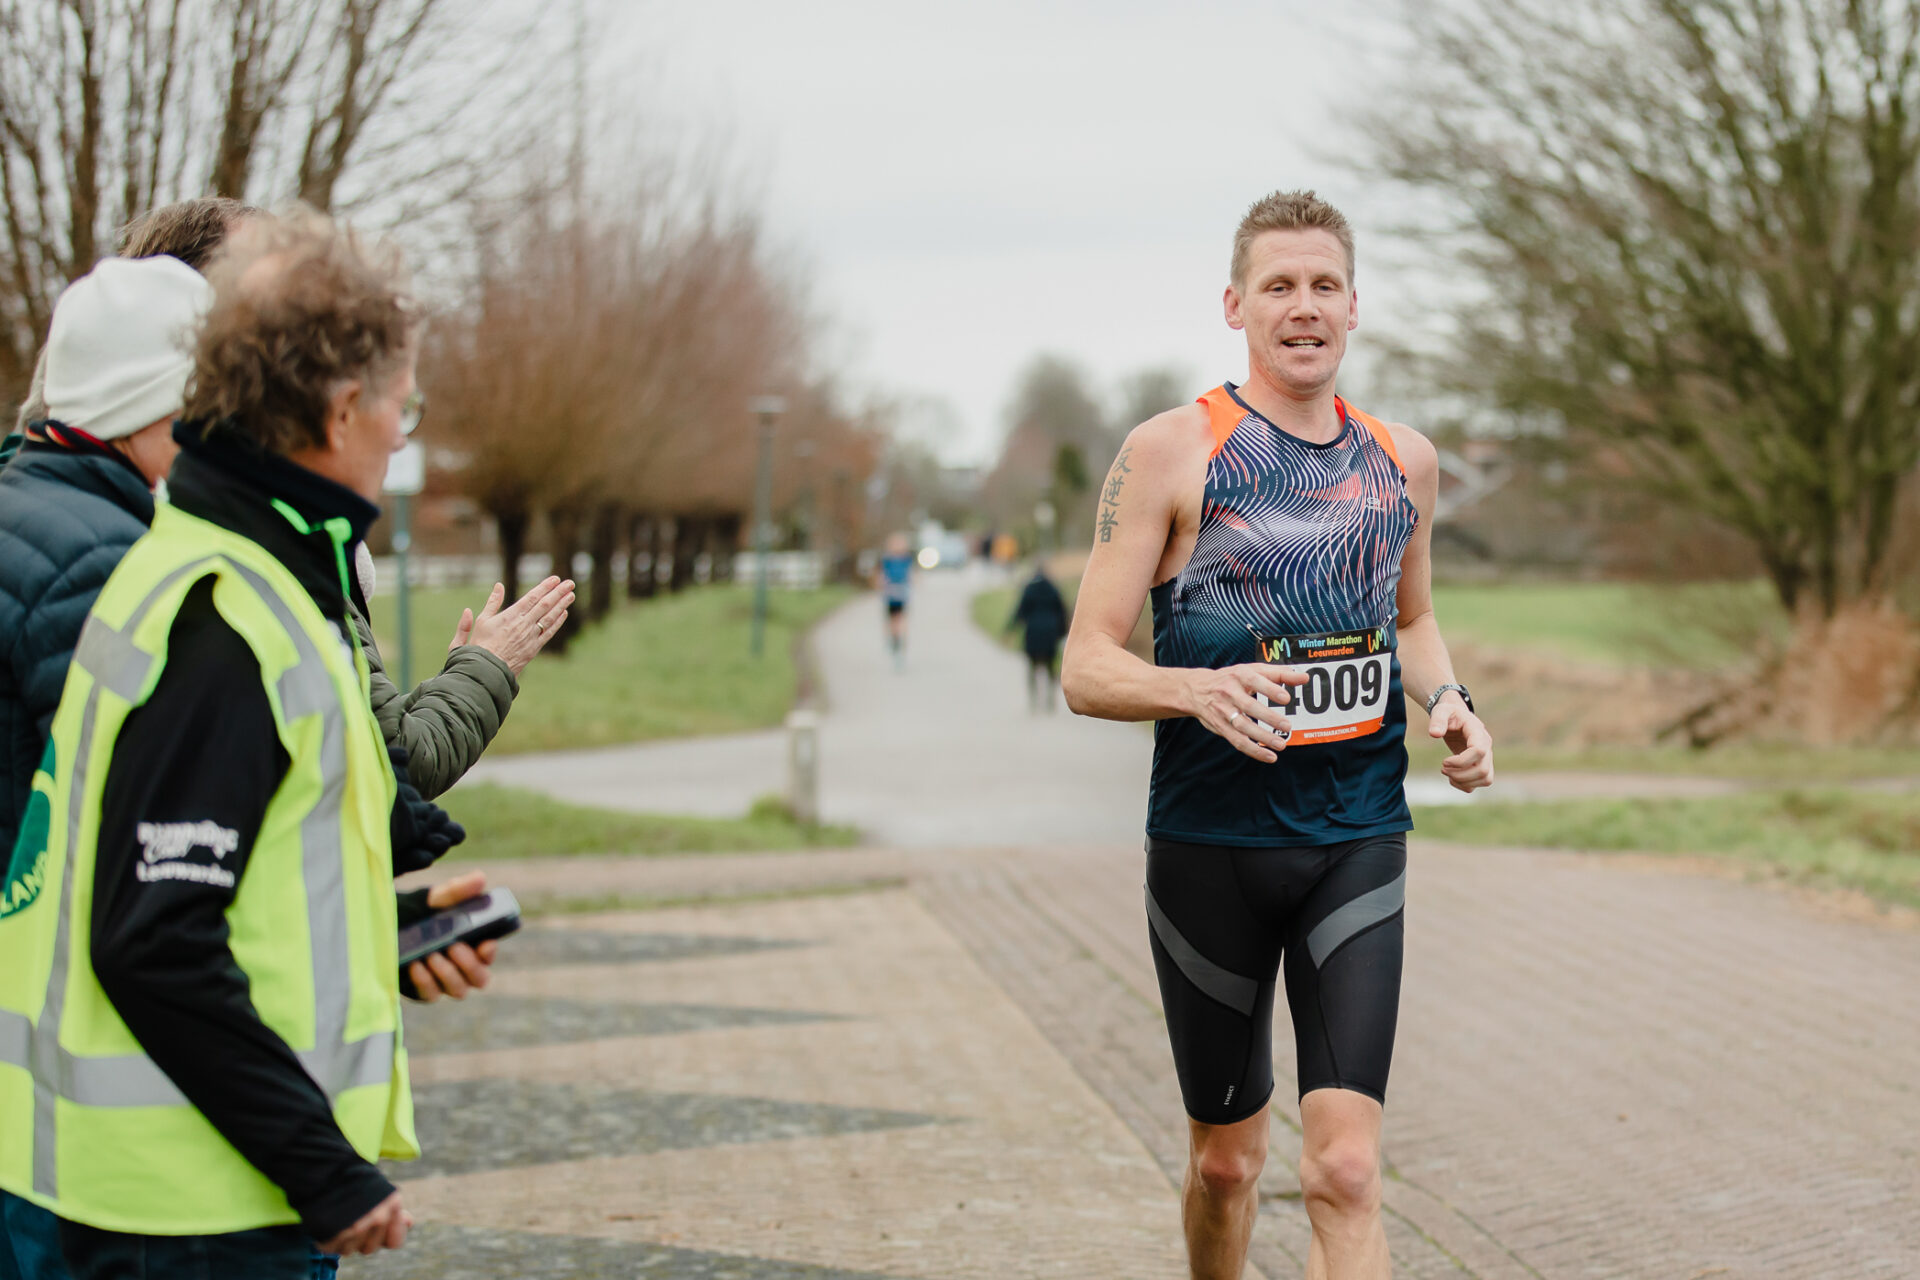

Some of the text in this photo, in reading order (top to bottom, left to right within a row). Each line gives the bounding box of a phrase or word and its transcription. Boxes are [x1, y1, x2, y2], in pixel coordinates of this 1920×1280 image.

[1298, 635, 1363, 649] Winter Marathon
[1307, 646, 1355, 658] Leeuwarden
